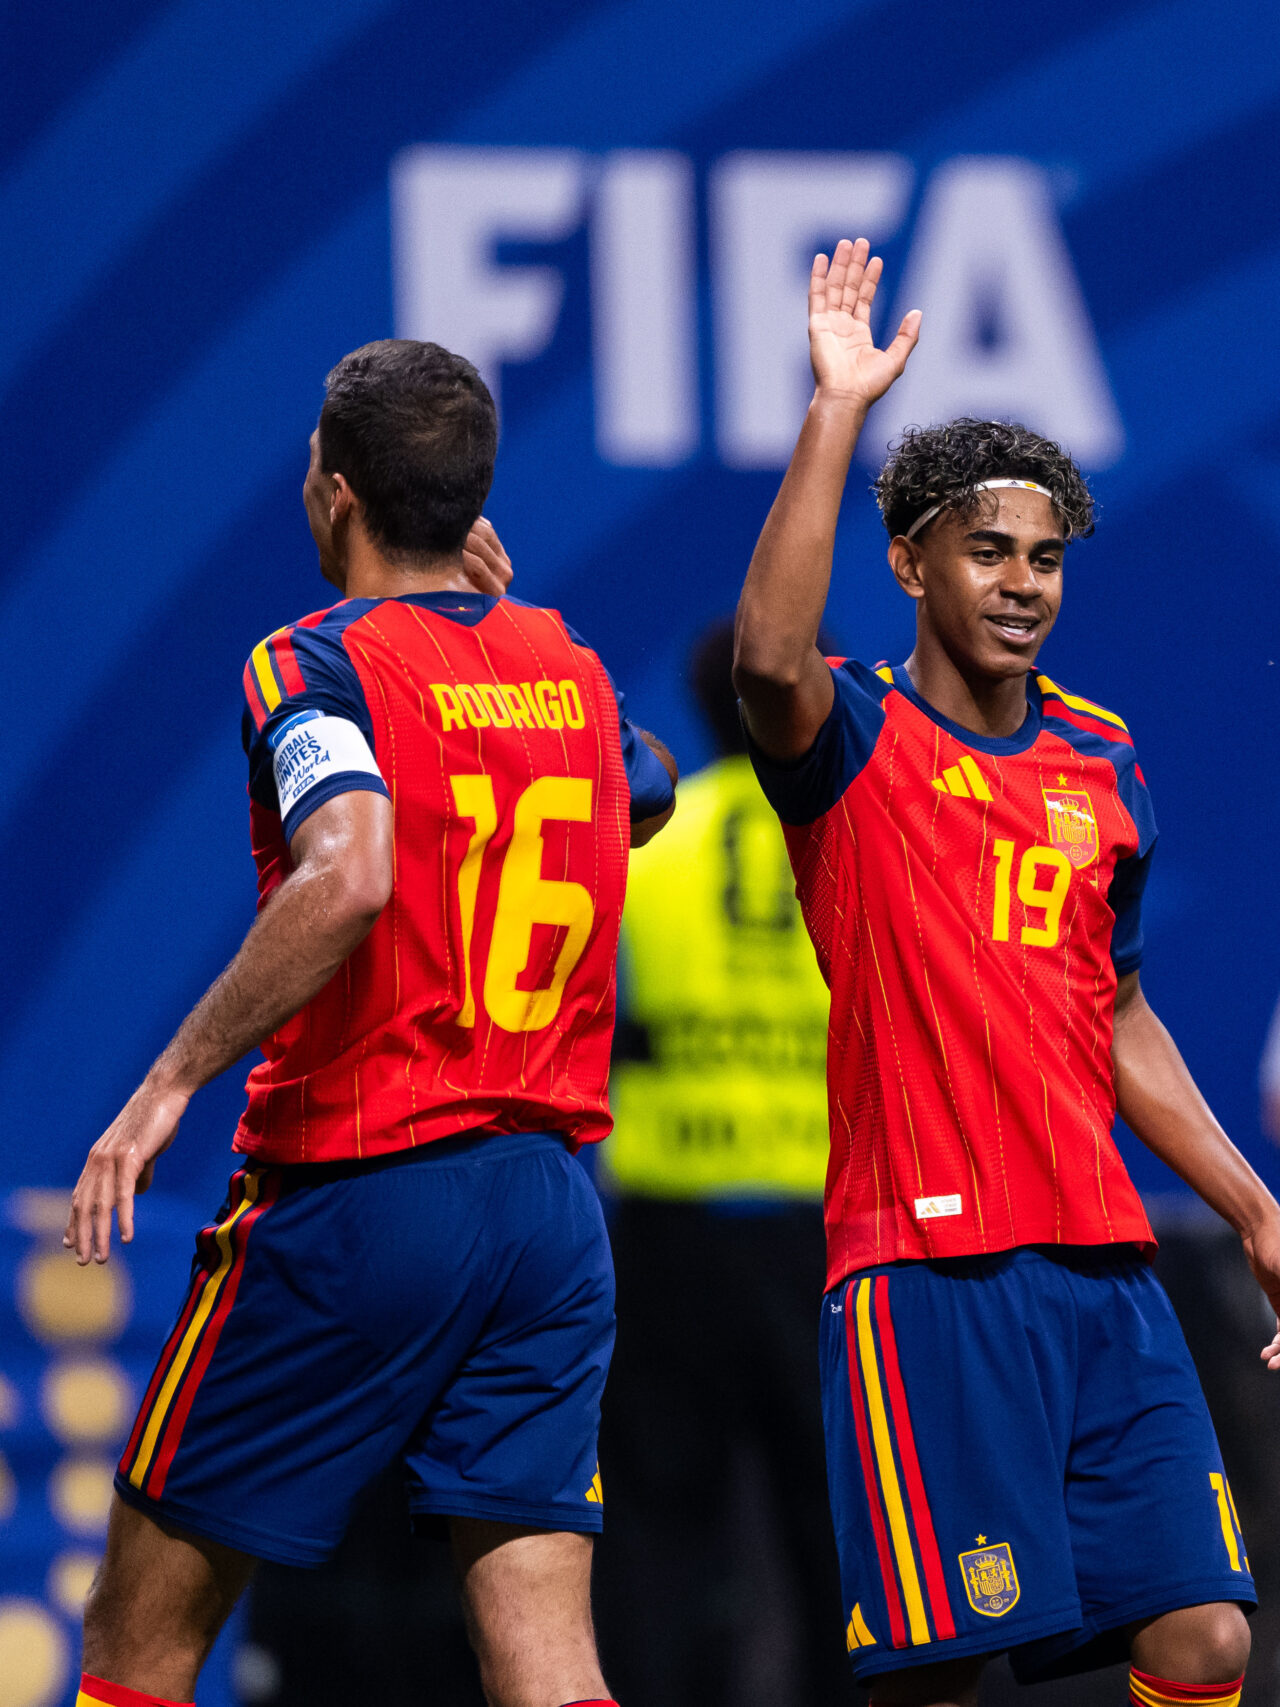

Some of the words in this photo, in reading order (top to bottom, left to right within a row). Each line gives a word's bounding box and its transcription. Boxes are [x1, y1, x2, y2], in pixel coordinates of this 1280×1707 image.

[390, 146, 1123, 468] FIFA
[429, 679, 586, 731] RODRIGO
[276, 731, 314, 776] FOOTBALL
[279, 740, 321, 789] UNITES
[293, 750, 331, 784] World
[450, 774, 596, 1032] 16
[993, 838, 1072, 947] 19
[1209, 1472, 1250, 1573] 1
